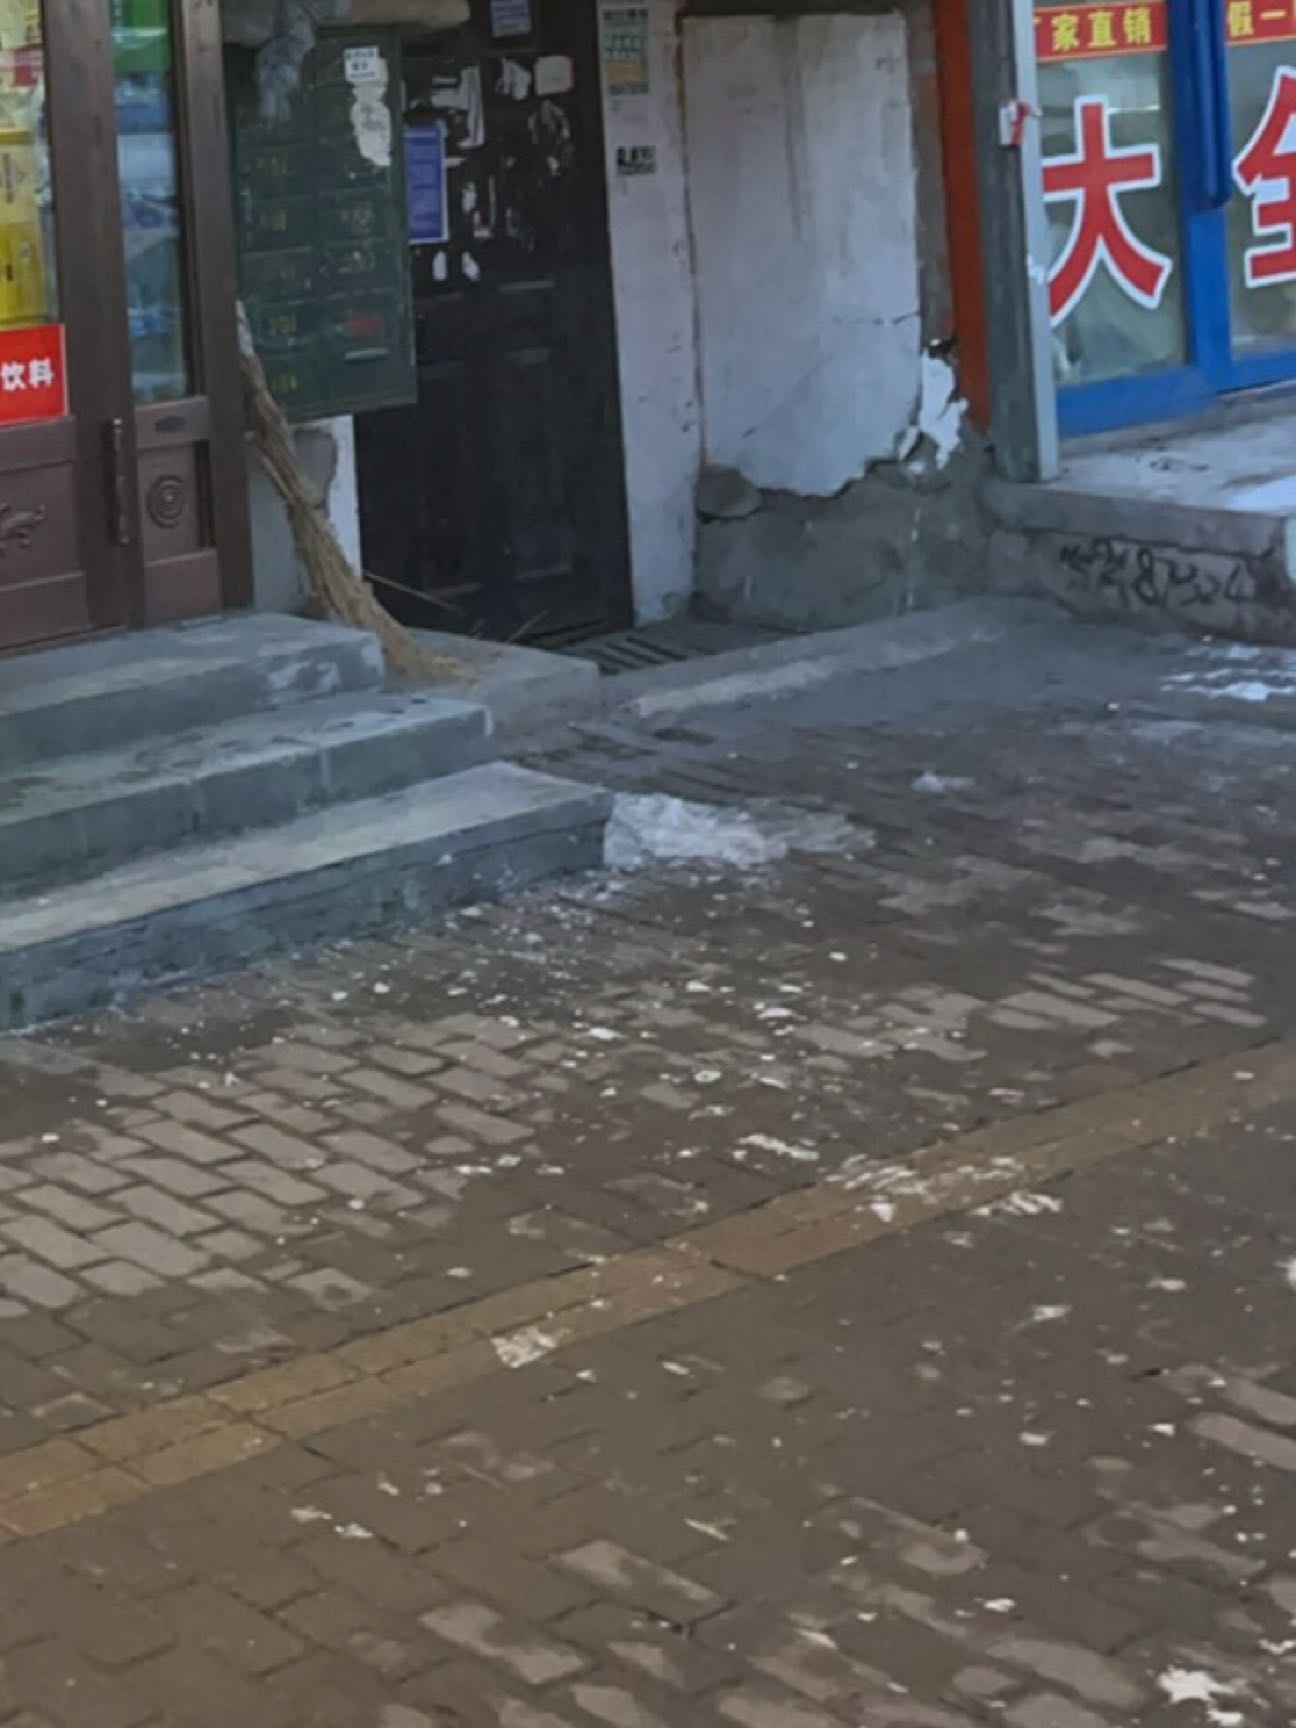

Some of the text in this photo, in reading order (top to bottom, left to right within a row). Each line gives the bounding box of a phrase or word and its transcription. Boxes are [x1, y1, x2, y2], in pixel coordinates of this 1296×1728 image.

[1033, 6, 1152, 51] 家直销
[1042, 93, 1173, 327] 大
